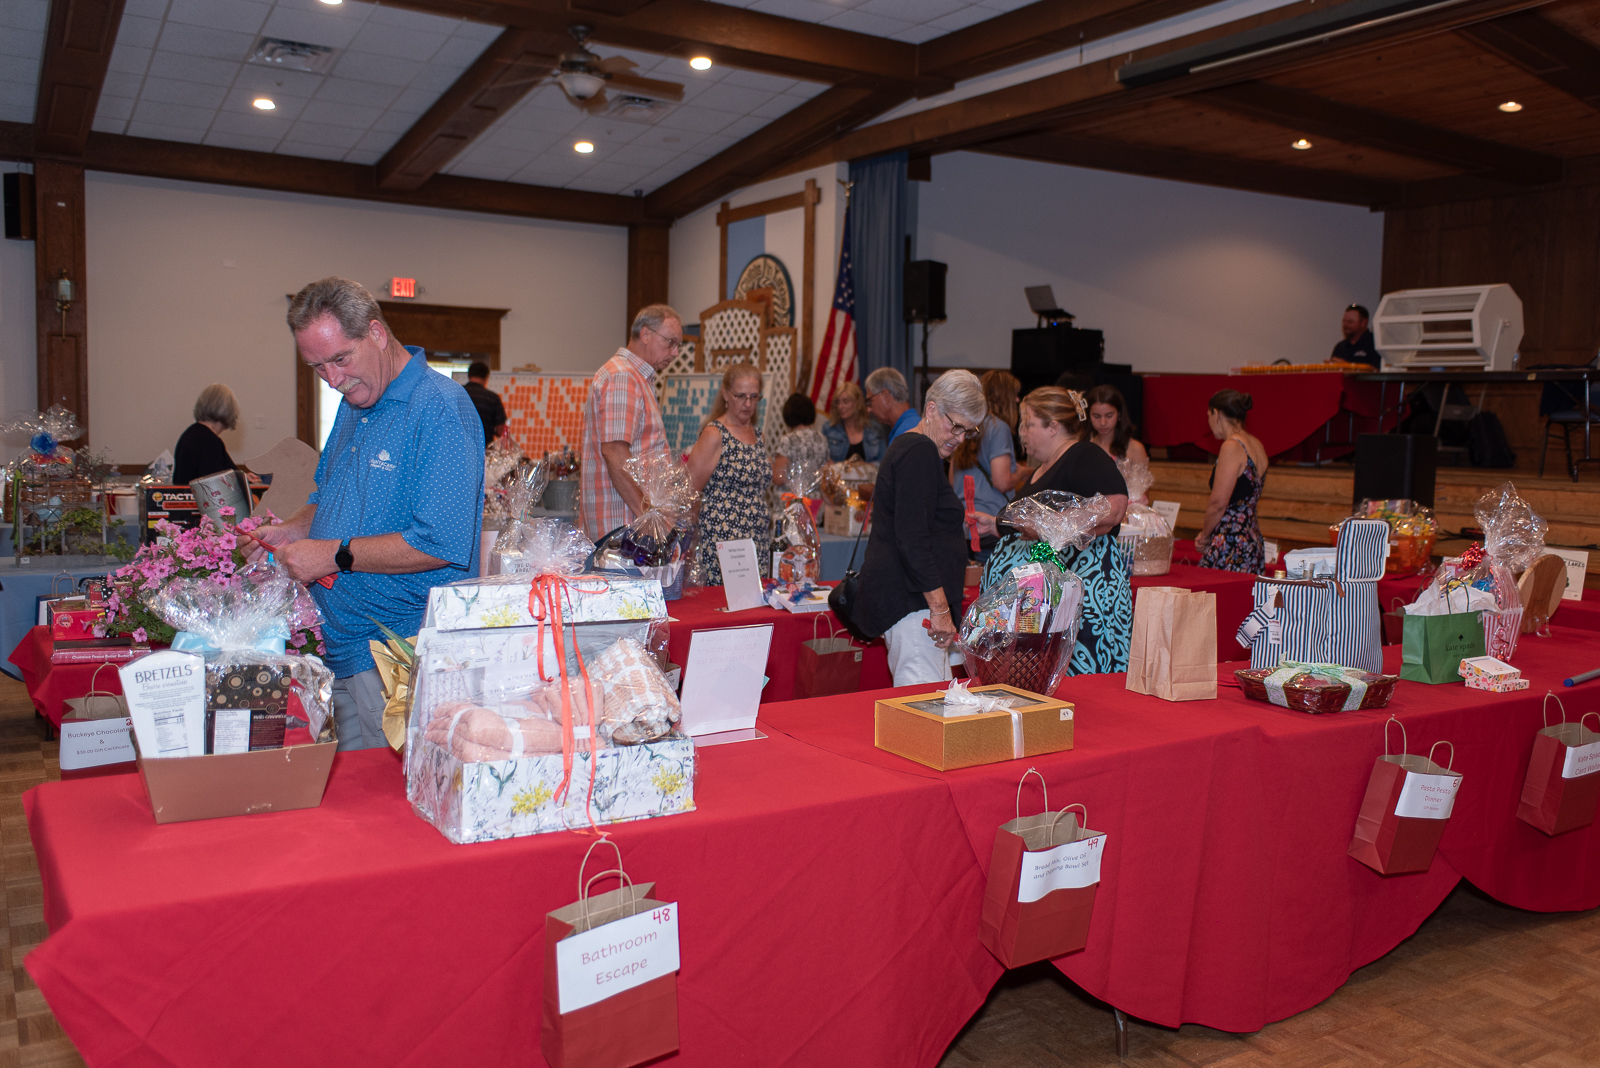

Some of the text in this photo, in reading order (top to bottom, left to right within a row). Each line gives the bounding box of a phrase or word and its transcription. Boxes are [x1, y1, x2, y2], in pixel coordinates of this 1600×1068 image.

[392, 277, 416, 298] EXIT
[1445, 641, 1475, 653] kate spade
[135, 664, 193, 684] BRETZELS
[67, 727, 133, 739] Buckeye Chocolate
[104, 744, 130, 752] Certificate
[1578, 755, 1588, 763] Kate
[1420, 784, 1452, 795] Pasta Pesto
[1424, 795, 1443, 804] Dinner
[1087, 837, 1099, 850] 49
[1033, 872, 1045, 880] and
[1045, 864, 1064, 876] Dipping
[1034, 862, 1051, 871] Bread
[652, 907, 671, 925] 48
[581, 931, 658, 966] Bathroom
[596, 958, 648, 985] Escape
